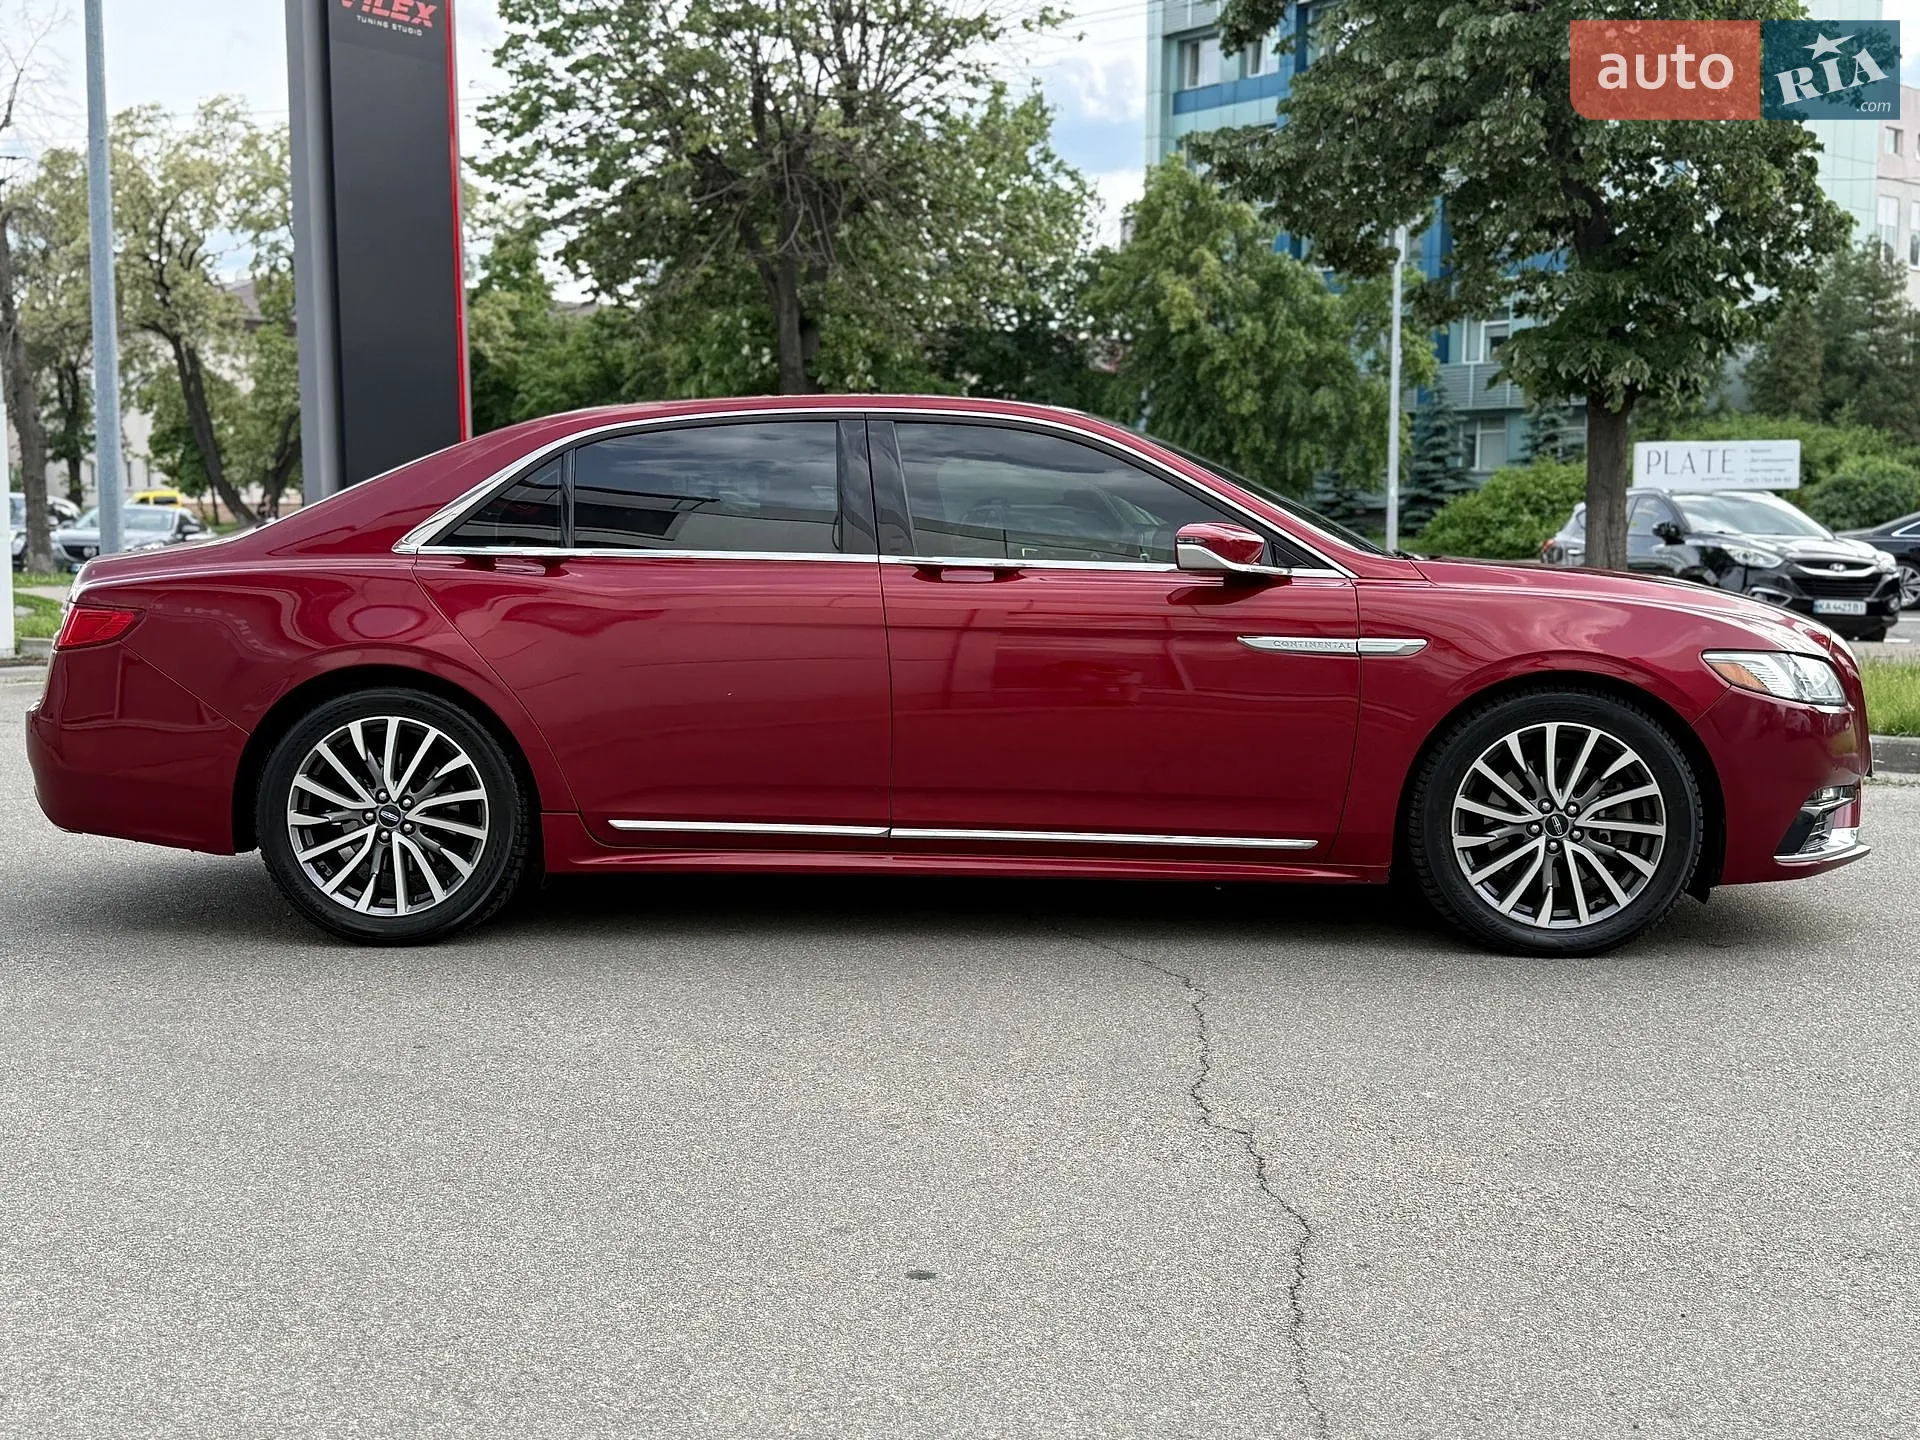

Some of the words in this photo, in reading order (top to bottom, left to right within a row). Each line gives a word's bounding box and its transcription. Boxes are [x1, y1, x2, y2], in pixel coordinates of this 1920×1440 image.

[356, 15, 389, 29] TUNING
[392, 25, 423, 37] STUDIO
[1646, 450, 1736, 475] PLATE
[1273, 640, 1352, 650] CONTINENTAL
